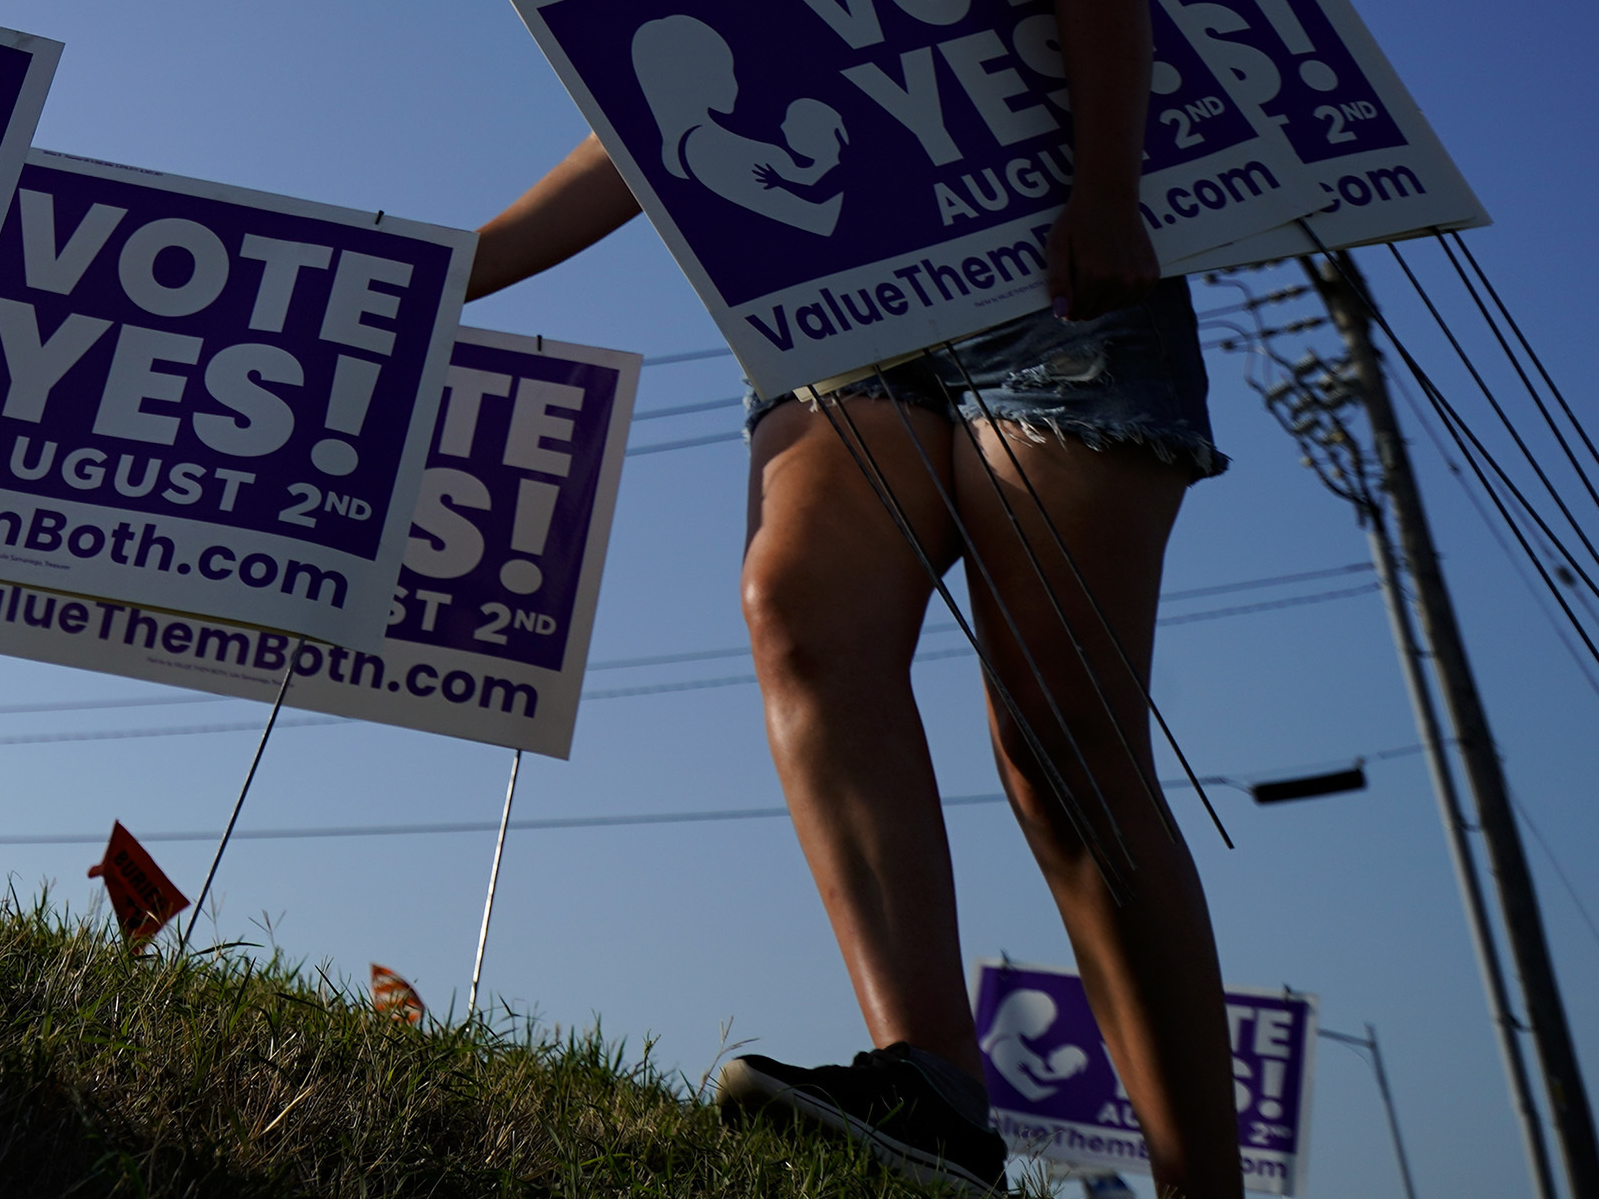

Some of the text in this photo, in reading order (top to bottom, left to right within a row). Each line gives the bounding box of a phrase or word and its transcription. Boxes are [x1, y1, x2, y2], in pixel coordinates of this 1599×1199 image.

[1158, 96, 1226, 150] 2ND
[1312, 100, 1379, 146] 2ND
[932, 142, 1074, 228] AUGU
[18, 187, 415, 357] VOTE
[438, 363, 587, 479] TE
[277, 482, 373, 529] 2ND
[402, 466, 562, 595] S!
[472, 601, 558, 647] 2ND
